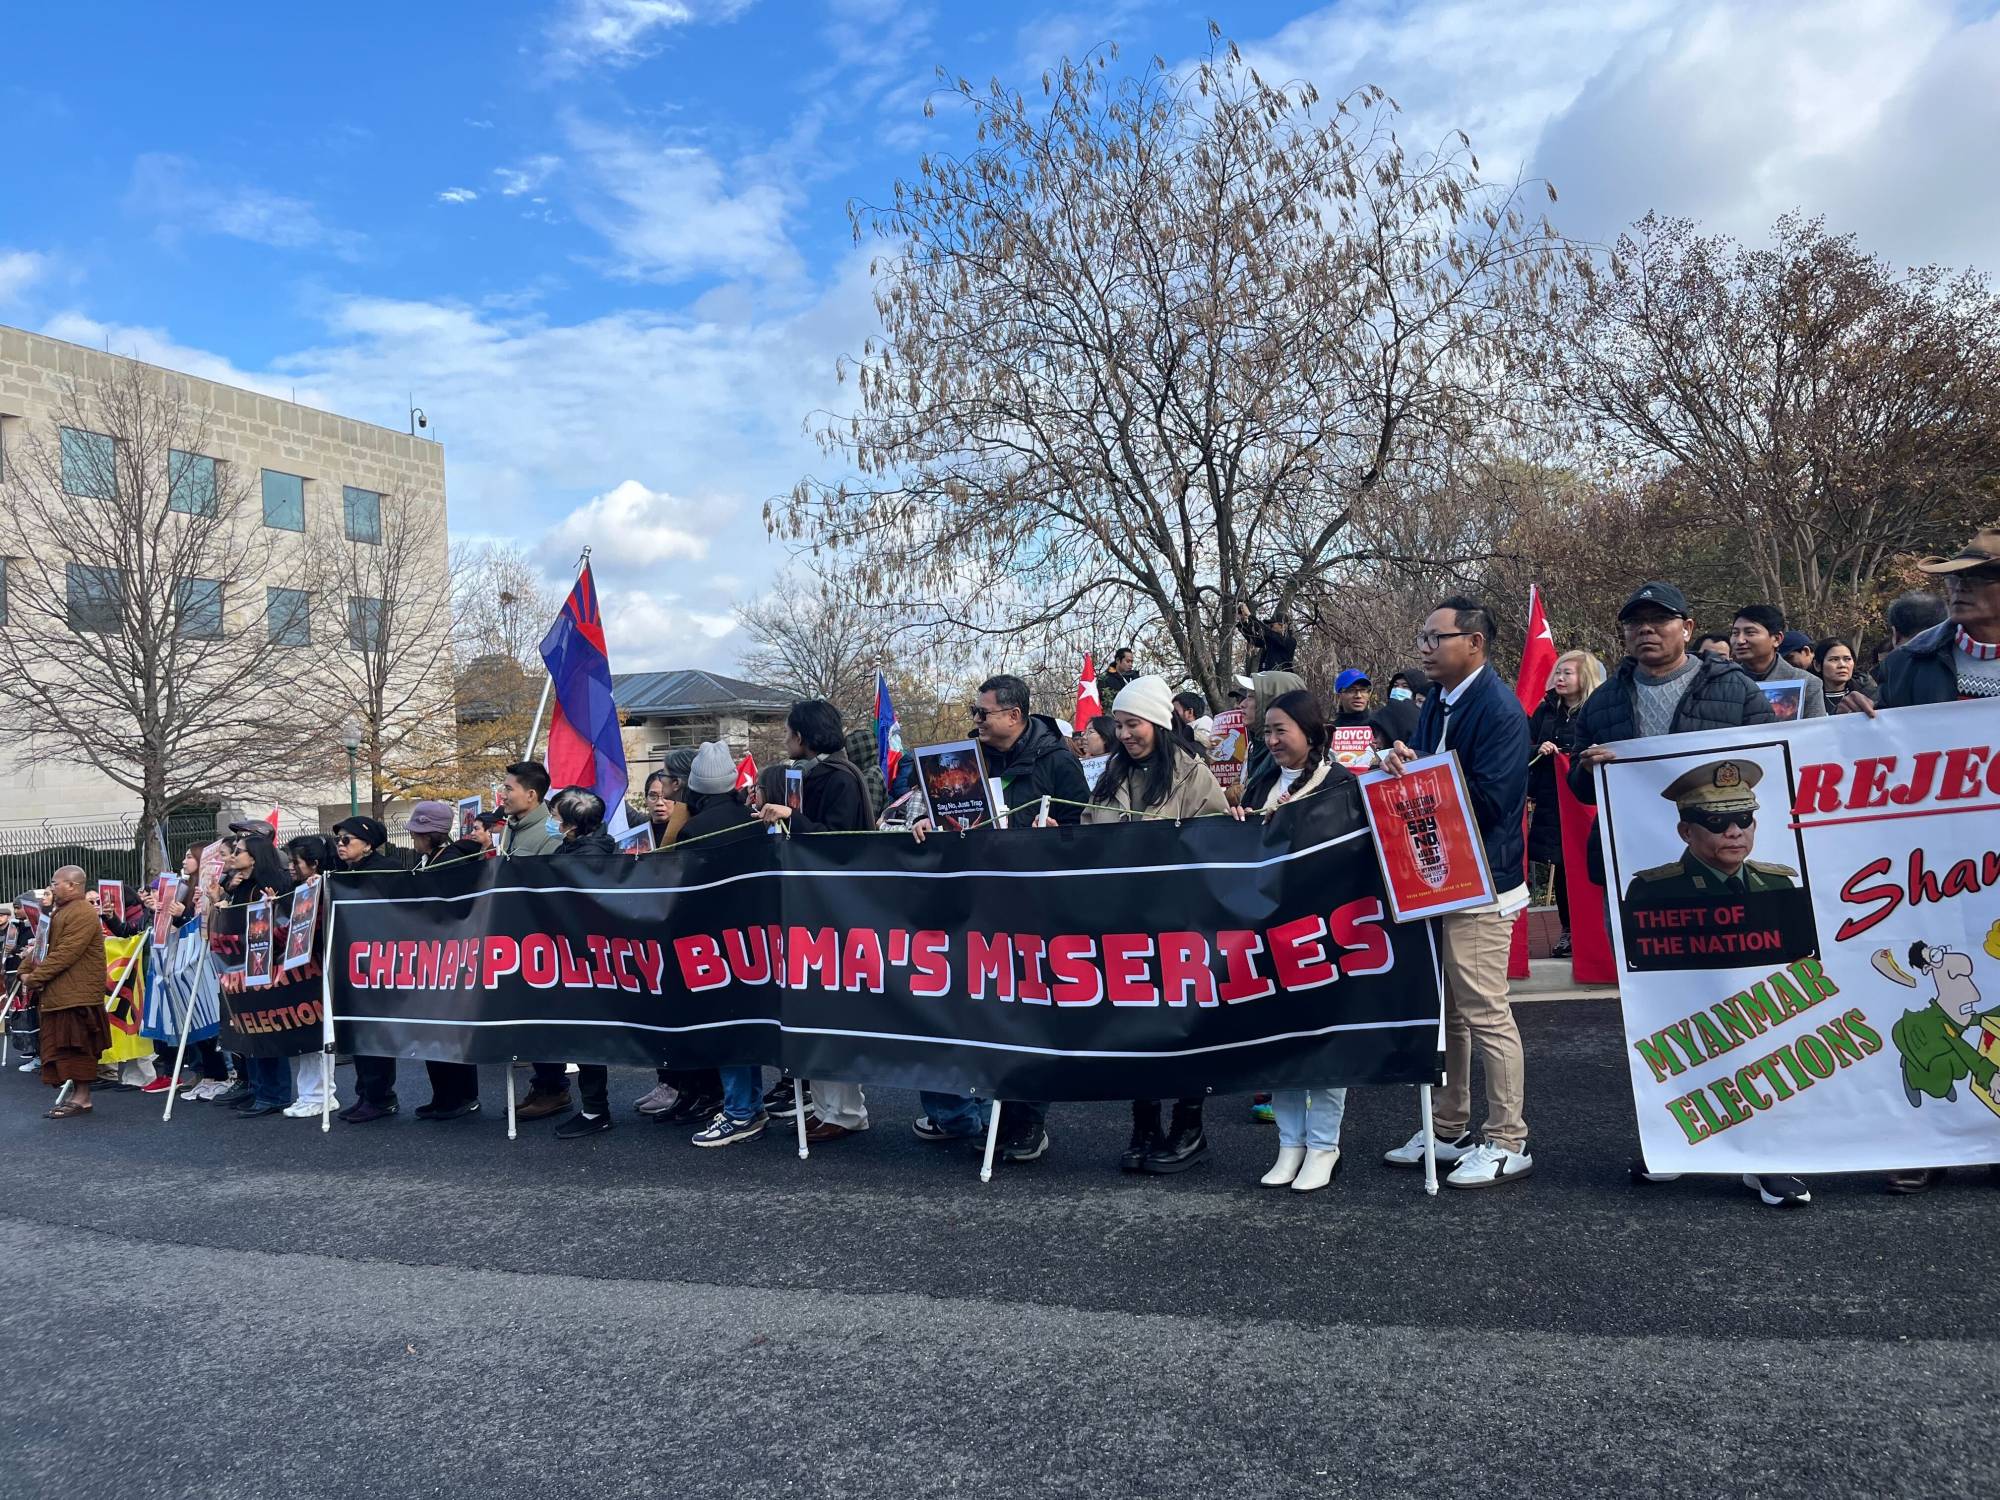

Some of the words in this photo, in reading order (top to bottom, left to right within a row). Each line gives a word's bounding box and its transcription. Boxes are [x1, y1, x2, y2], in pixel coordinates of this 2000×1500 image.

[1335, 730, 1371, 740] BOYCO
[1210, 764, 1235, 772] MARCH
[937, 803, 948, 811] Say
[1418, 847, 1439, 858] JUST
[1633, 908, 1707, 929] THEFT
[1714, 906, 1745, 925] OF
[349, 938, 480, 990] CHINA'S
[482, 932, 664, 995] POLICY
[967, 895, 1395, 1008] MISERIES
[1636, 937, 1685, 955] THE
[1689, 929, 1782, 954] NATION
[241, 1000, 324, 1034] ELECTION
[1634, 957, 1840, 1084] MYANMAR
[1665, 1007, 1883, 1145] ELECTIONS
